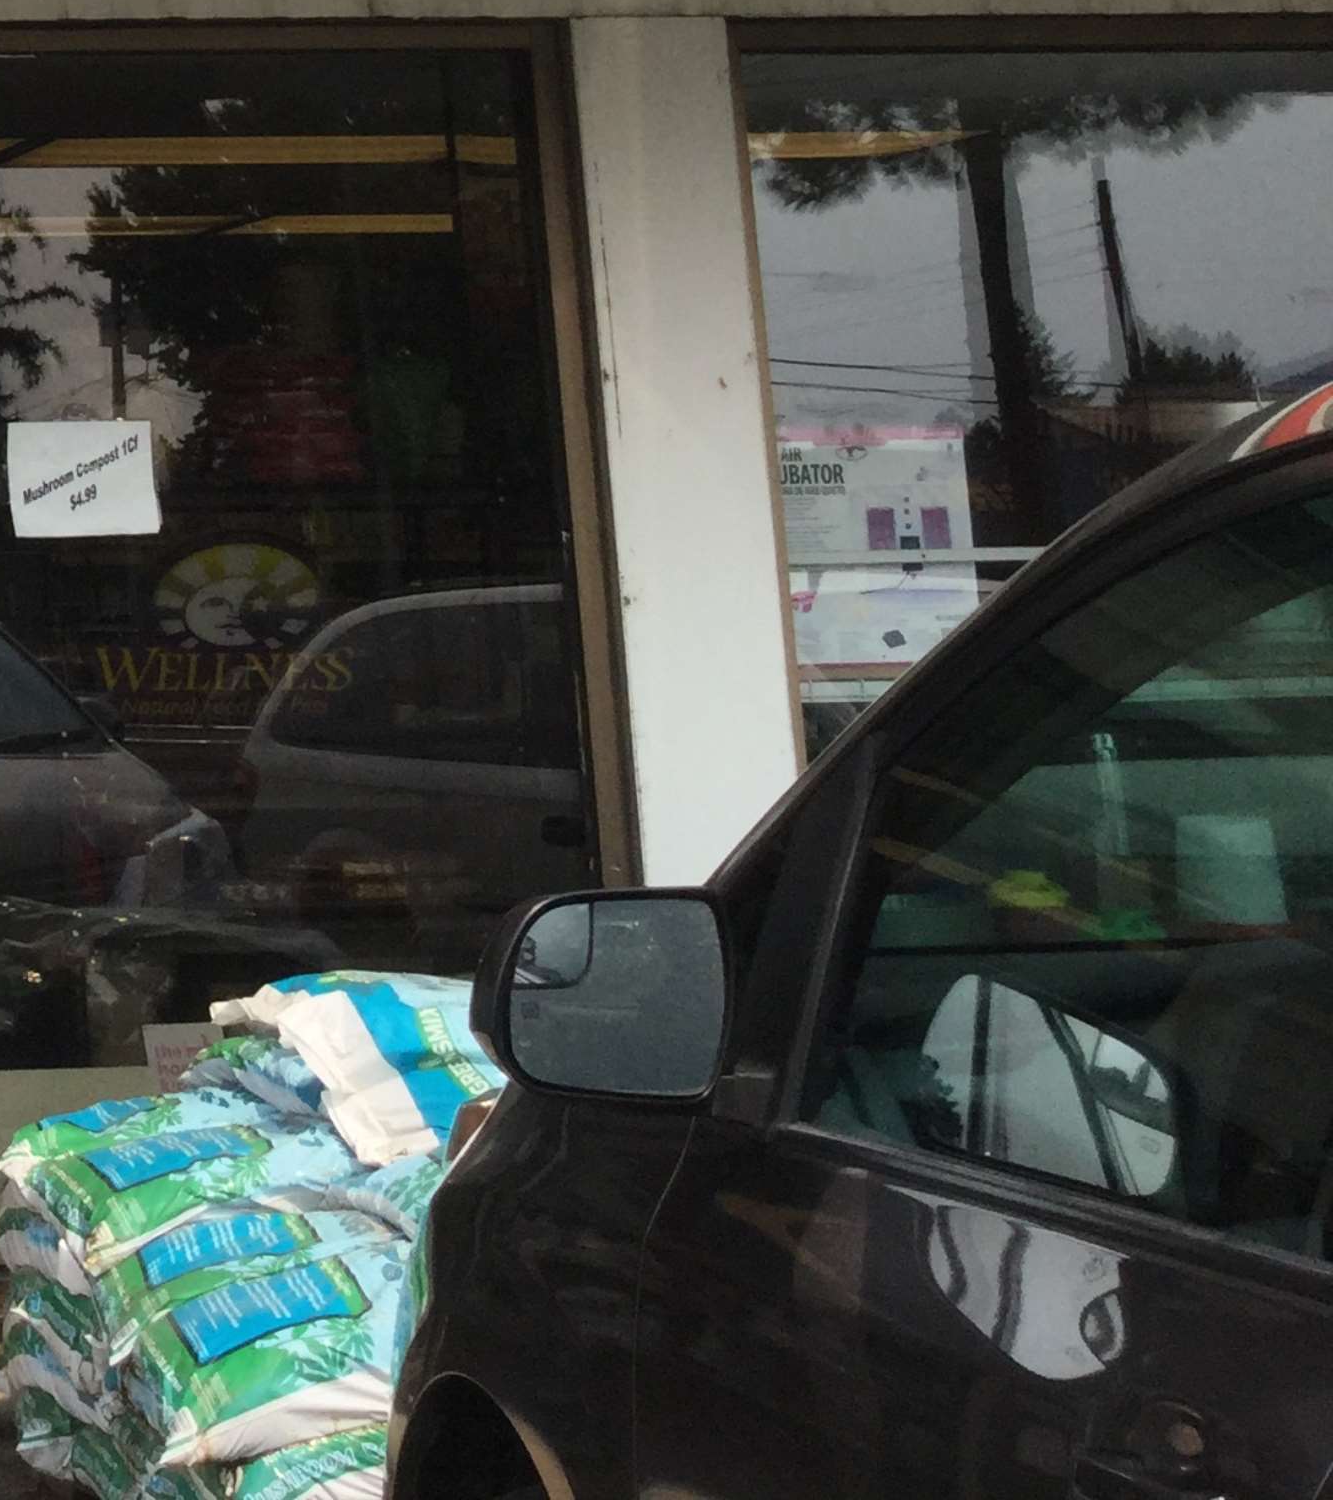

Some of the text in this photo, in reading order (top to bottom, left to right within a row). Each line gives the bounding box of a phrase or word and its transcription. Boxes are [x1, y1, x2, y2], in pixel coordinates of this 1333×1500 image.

[22, 470, 75, 505] Mushroom
[75, 446, 120, 478] Compost
[69, 484, 98, 511] $4.99
